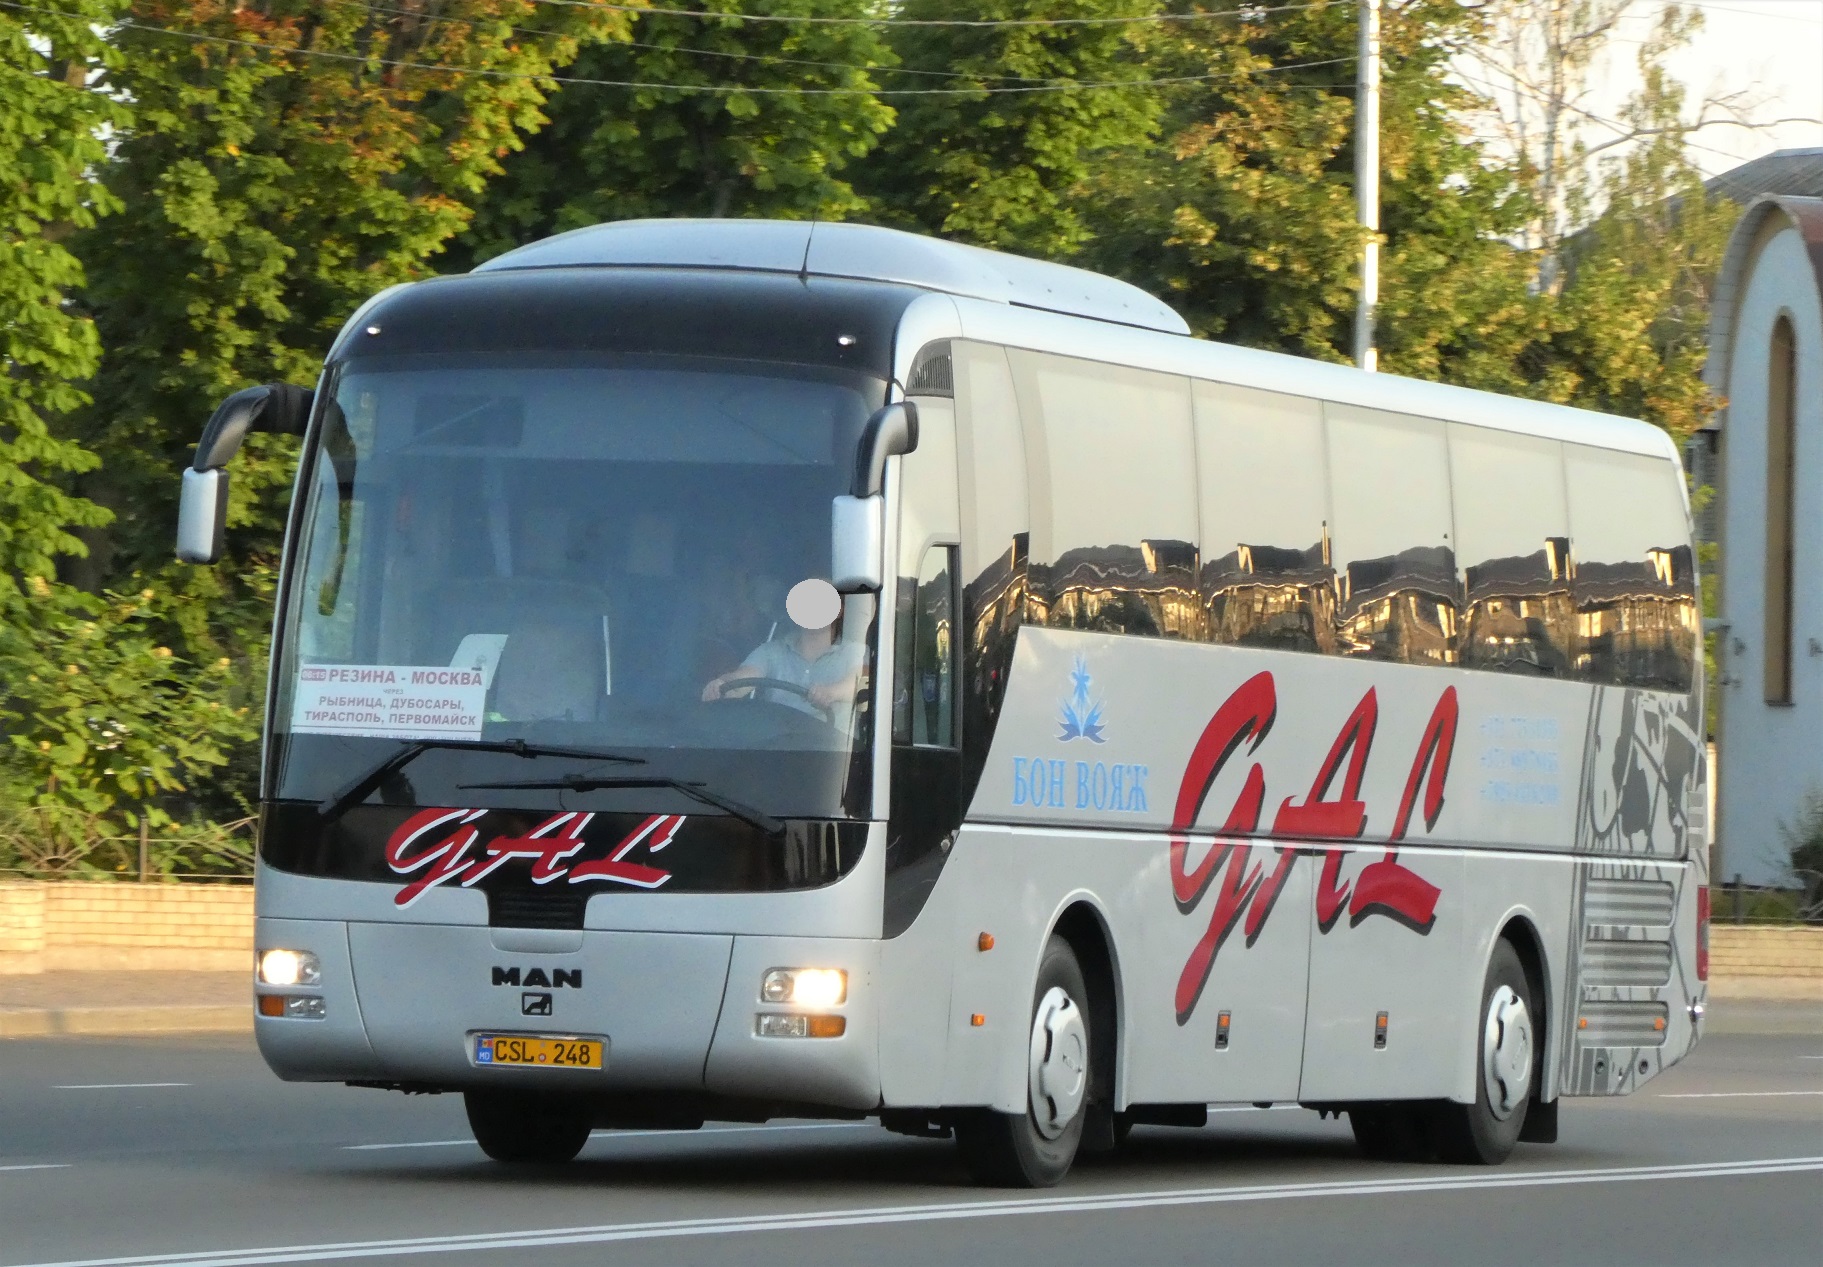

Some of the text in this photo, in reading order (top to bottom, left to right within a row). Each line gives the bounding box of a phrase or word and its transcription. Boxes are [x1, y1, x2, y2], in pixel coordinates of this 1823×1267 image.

[329, 669, 395, 684] РЕЗИНА
[411, 672, 482, 686] МОСКВА
[319, 696, 465, 712] РЫБНИЦА, ДУБОСАРЫ,
[305, 711, 476, 726] ТИРАСПОЛЬ, ПЕРВОМАЙСК
[1012, 756, 1149, 813] БОН ВОЯЖ
[385, 807, 687, 910] GAL
[1170, 671, 1459, 1027] GAL
[492, 966, 582, 988] MAN
[479, 1040, 591, 1065] MD CSL 248
